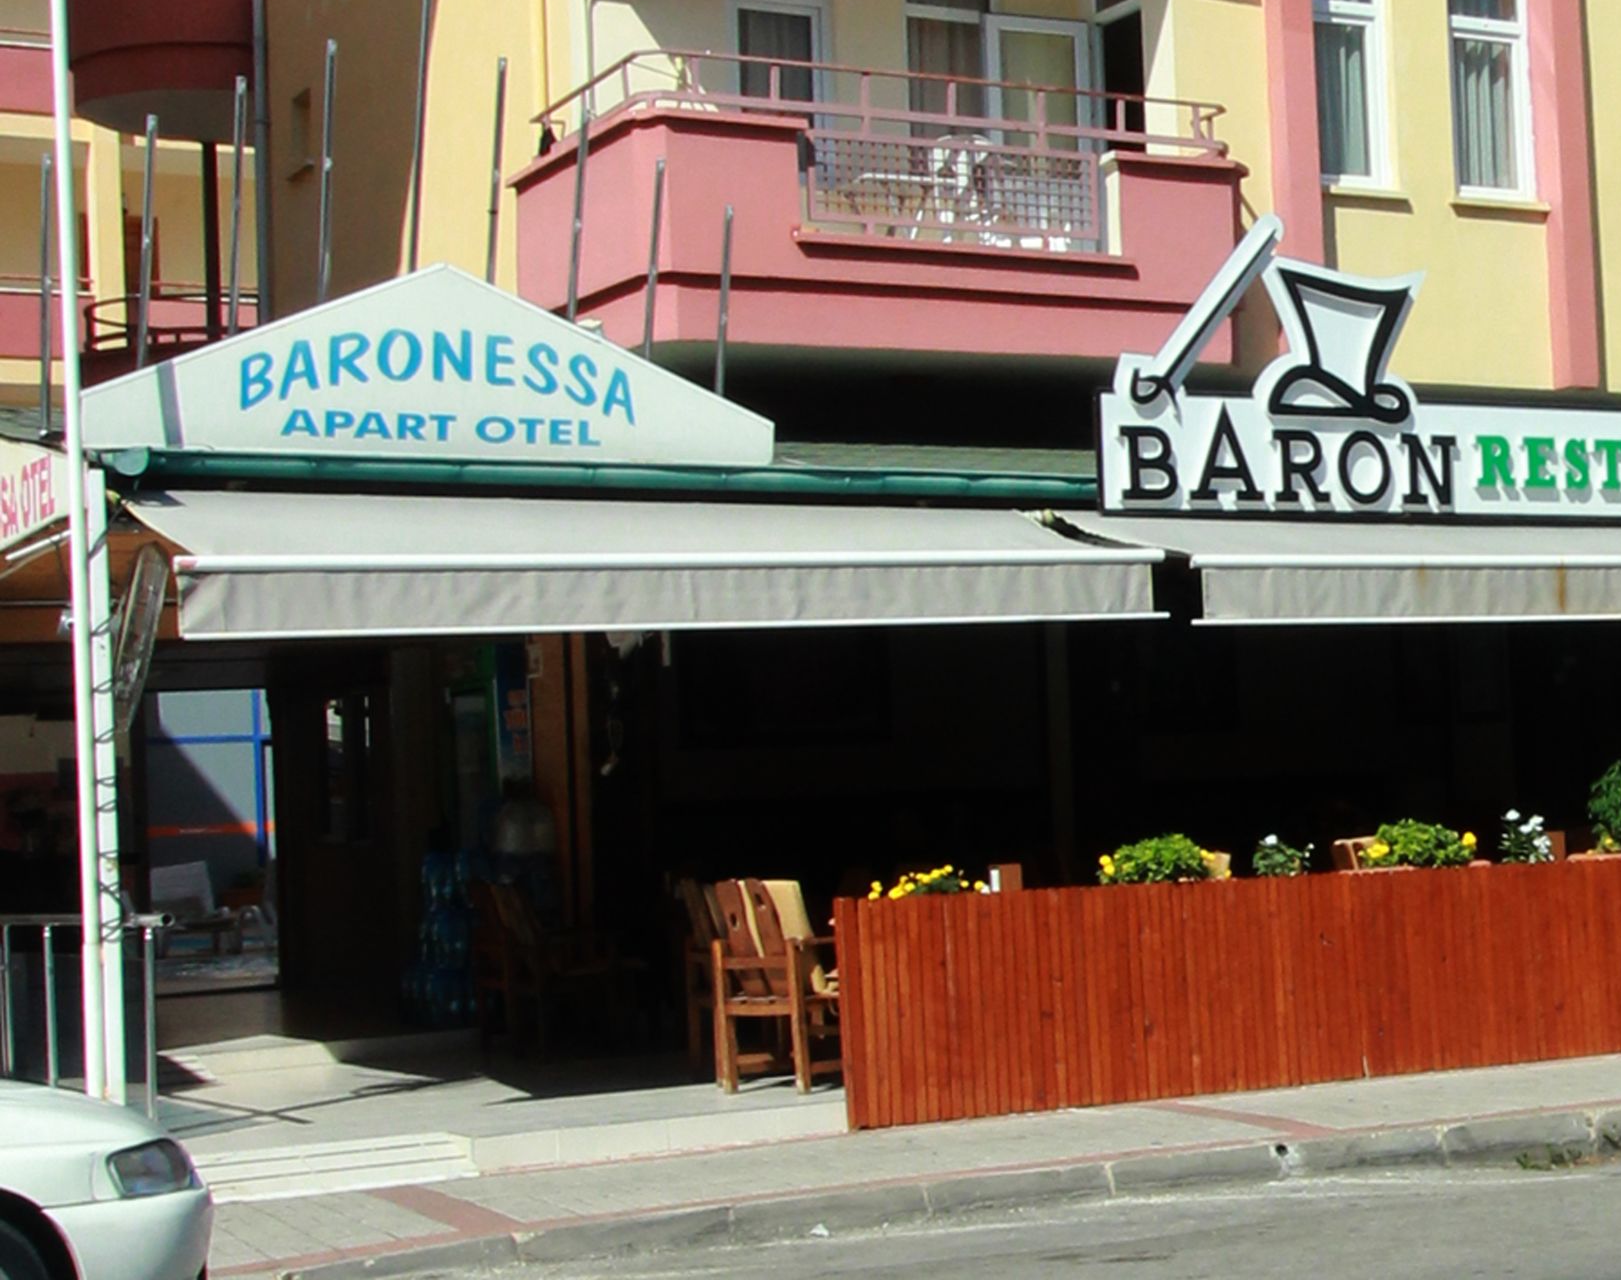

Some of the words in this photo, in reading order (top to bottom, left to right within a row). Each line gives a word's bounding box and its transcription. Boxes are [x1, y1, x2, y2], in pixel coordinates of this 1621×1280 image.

[240, 328, 636, 425] BARONESSA
[280, 408, 458, 441] APART
[475, 415, 602, 447] OTEL
[1118, 401, 1457, 505] BARON
[20, 452, 55, 529] OTEL
